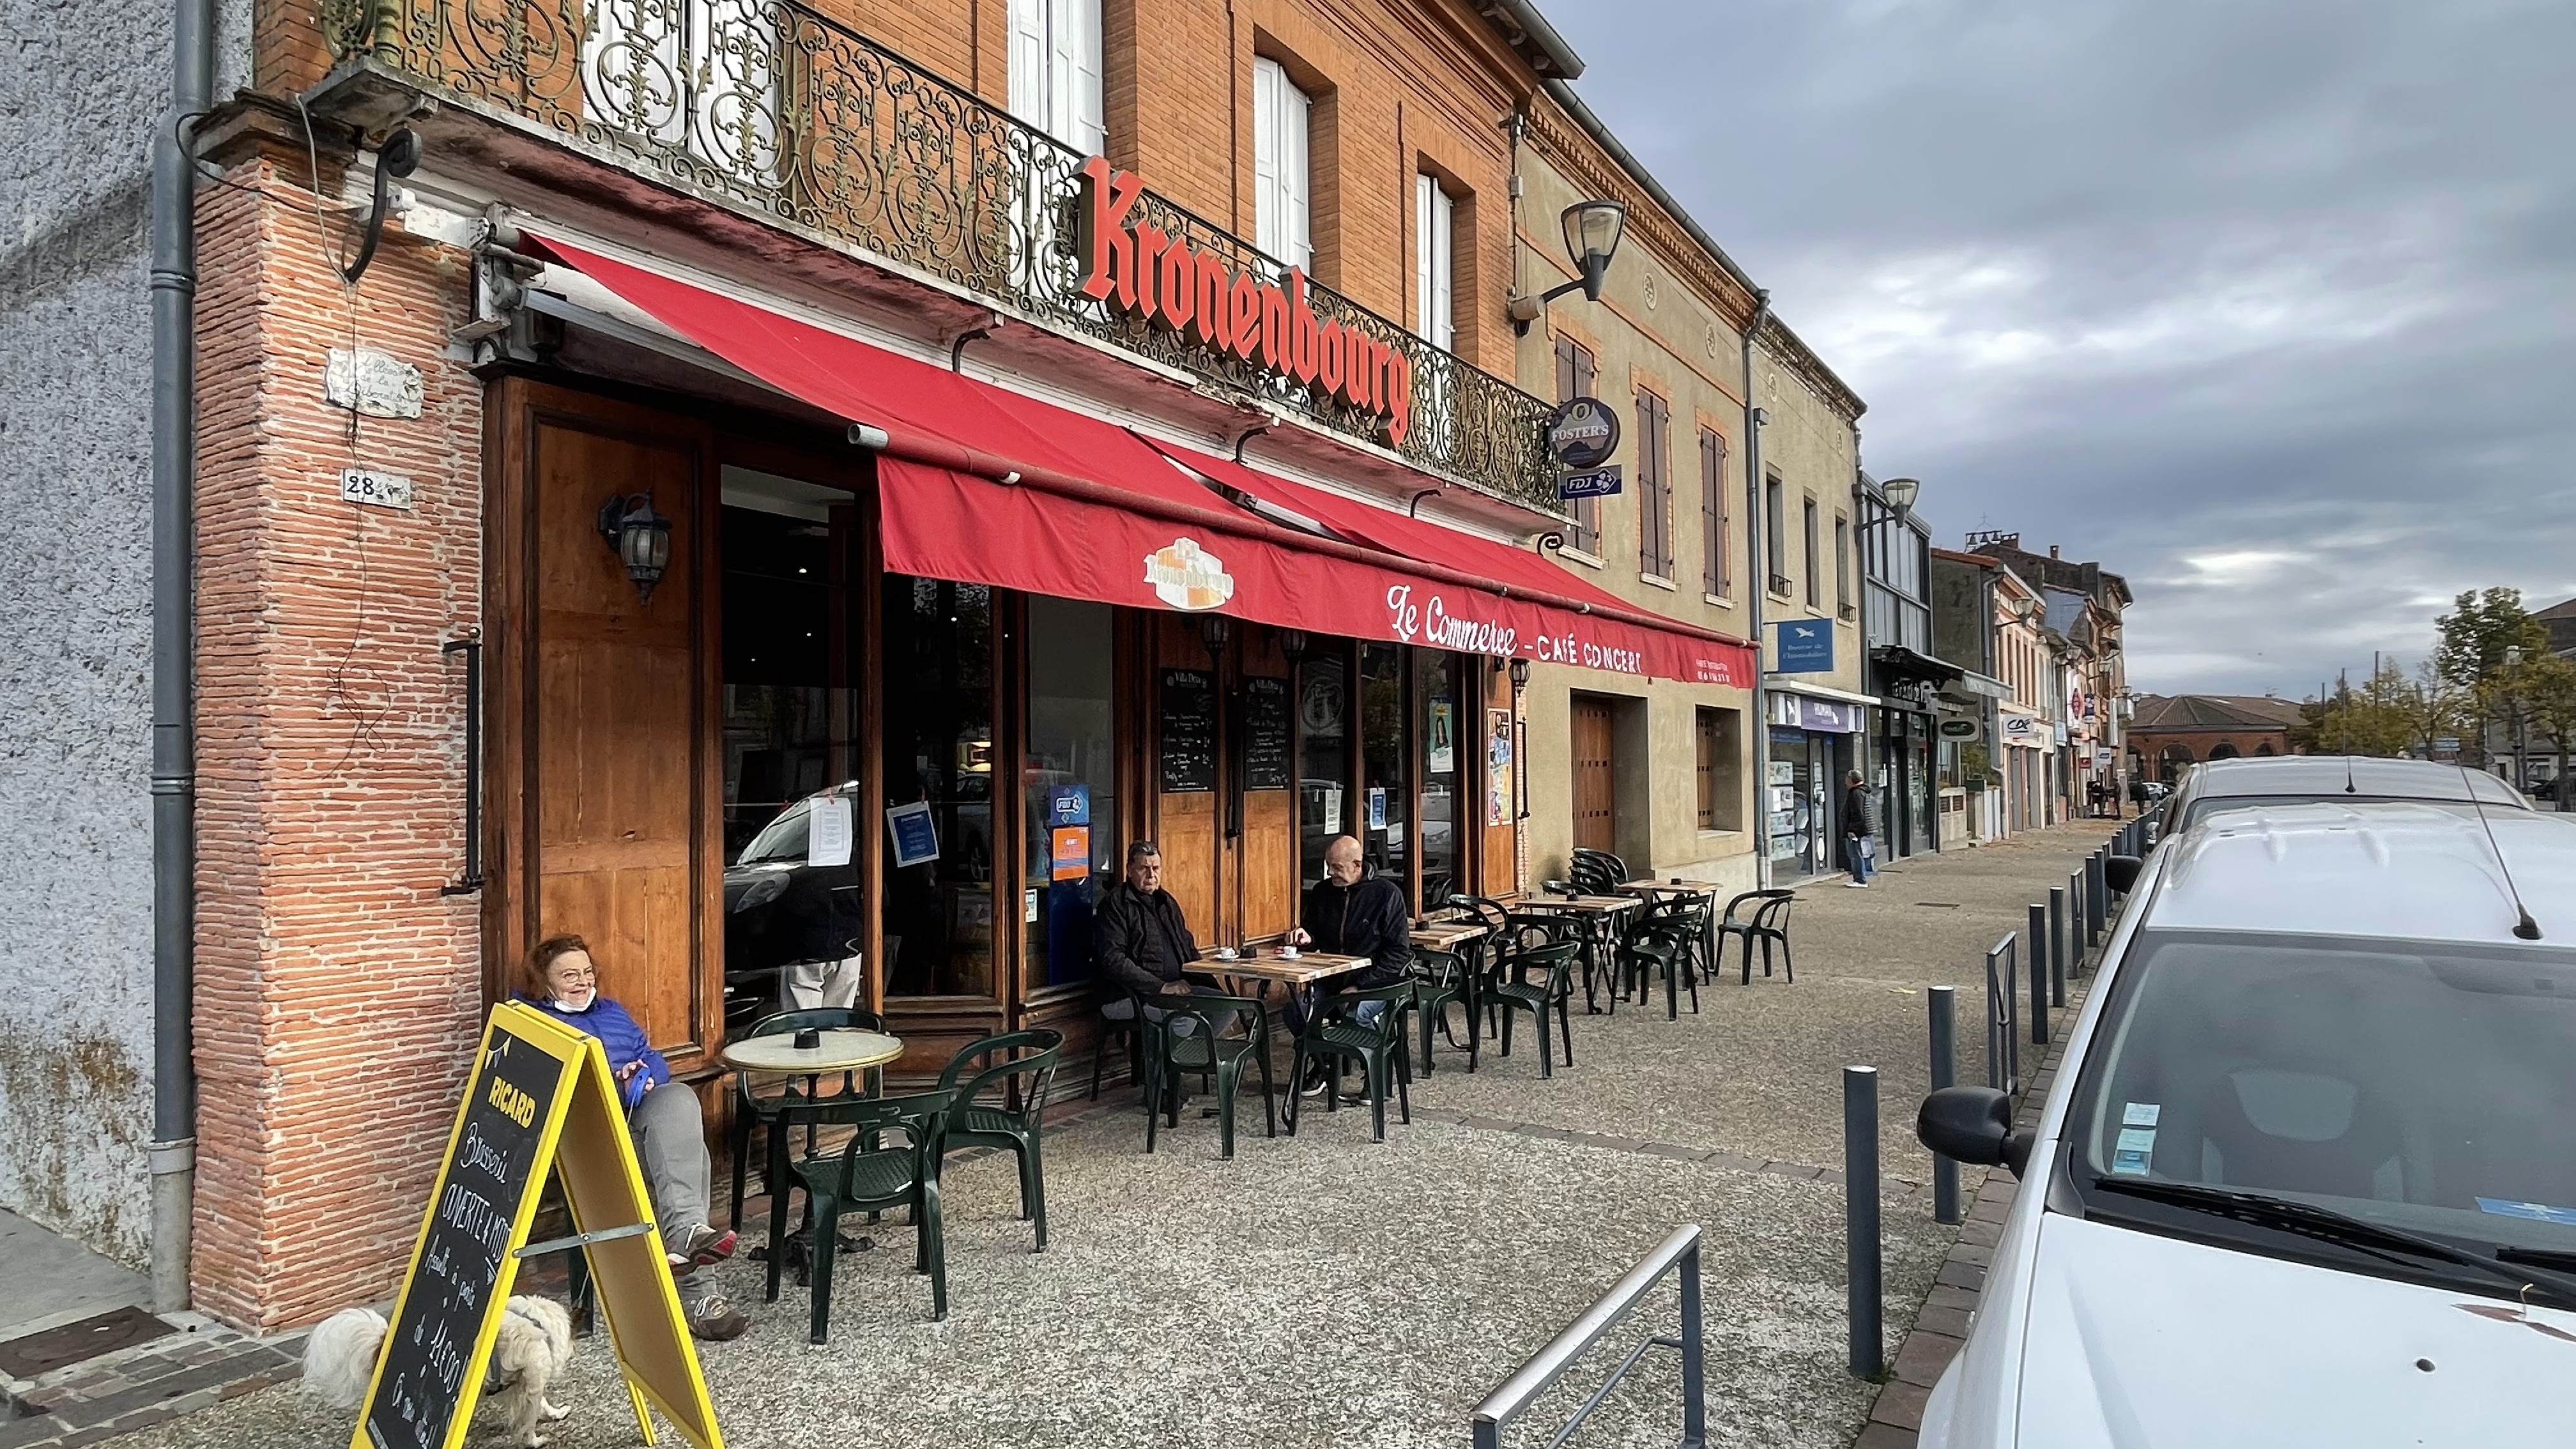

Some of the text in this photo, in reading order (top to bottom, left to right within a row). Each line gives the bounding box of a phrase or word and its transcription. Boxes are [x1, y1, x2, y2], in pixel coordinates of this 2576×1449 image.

[1081, 155, 1410, 447] Kronenbourg
[346, 475, 374, 495] 28
[1568, 477, 1592, 489] FDJ
[1386, 585, 1420, 642] Le
[1426, 595, 1518, 656] Commerce
[1537, 632, 1578, 664] CAFÉ
[1583, 642, 1643, 673] CONCERT
[487, 1075, 536, 1129] RICARD
[442, 1183, 491, 1241] OUVERTE
